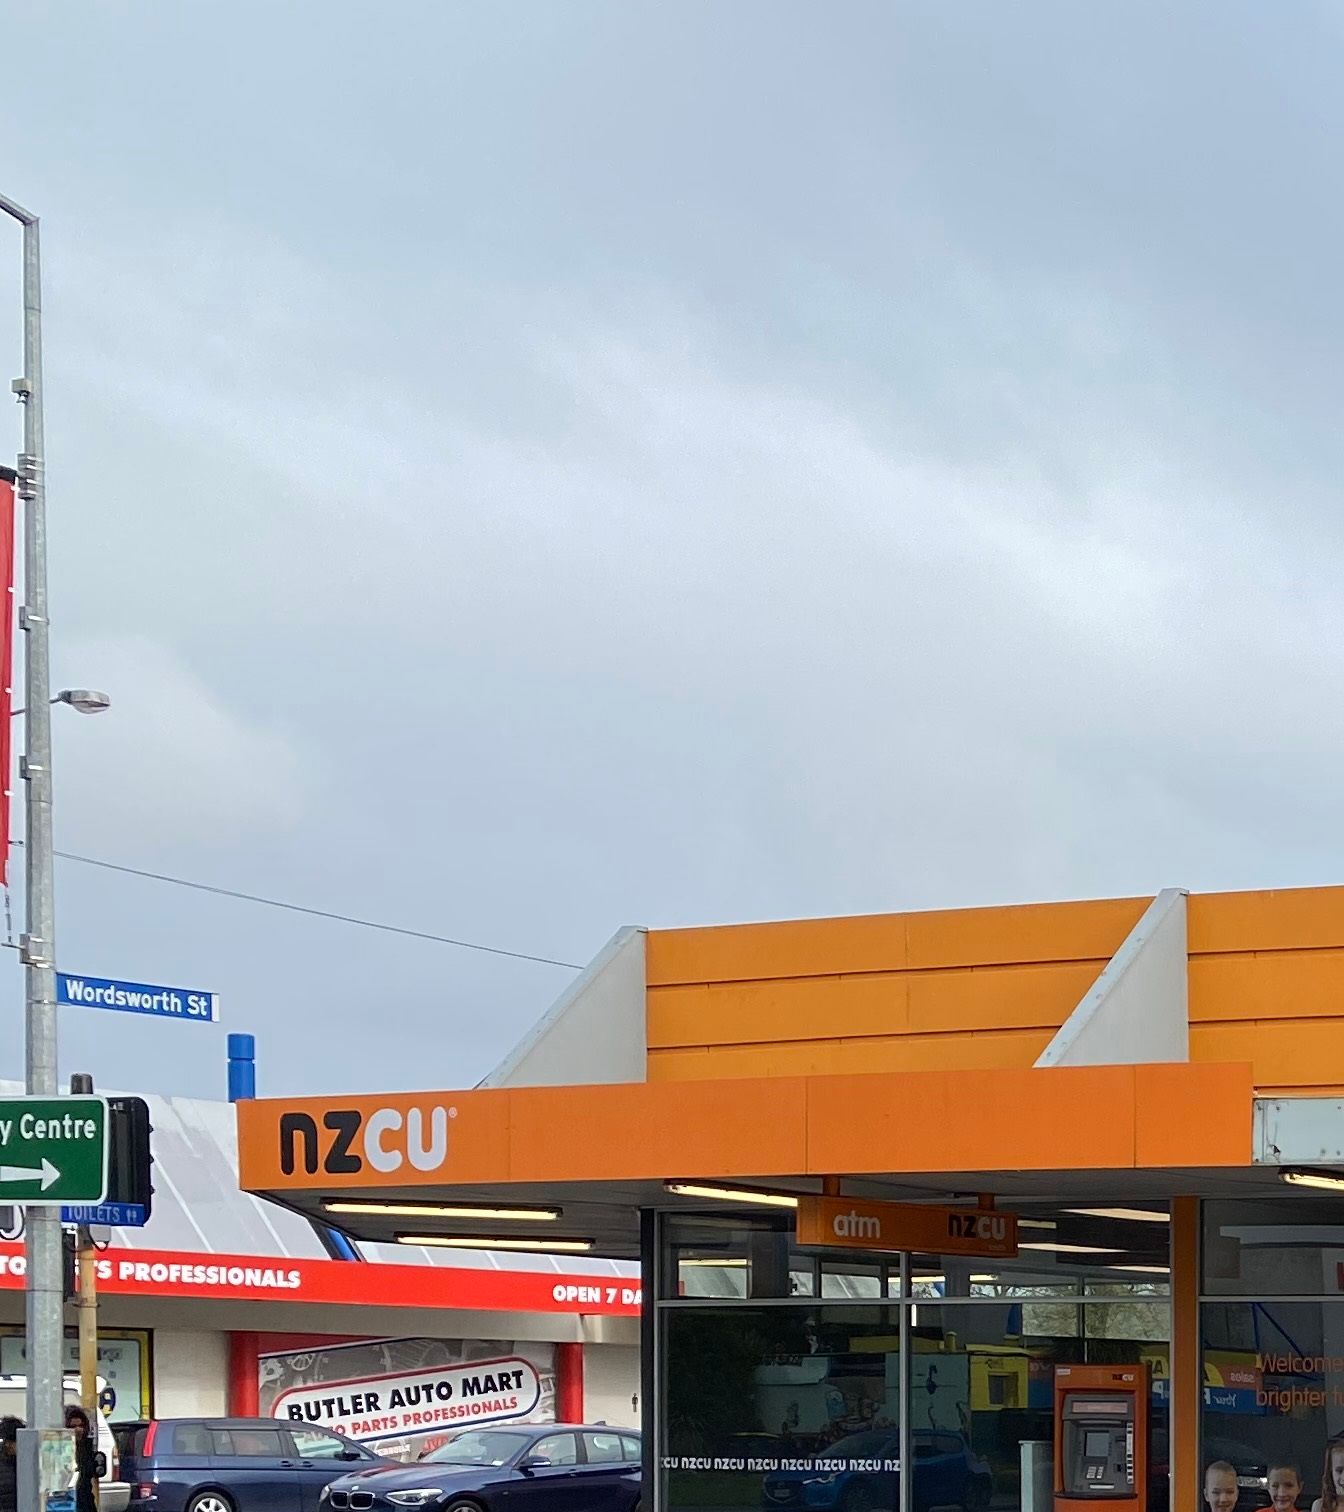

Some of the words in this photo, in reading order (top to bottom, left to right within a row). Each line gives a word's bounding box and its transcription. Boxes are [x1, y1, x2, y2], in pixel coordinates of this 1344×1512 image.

[65, 979, 182, 1013] Wordsworth
[187, 995, 207, 1016] St
[0, 1120, 13, 1146] y
[20, 1113, 96, 1140] Centre
[68, 1206, 120, 1222] TOILETS
[833, 1210, 881, 1239] atm
[119, 1261, 301, 1289] PROFESSIONALS
[553, 1285, 601, 1303] OPEN
[605, 1288, 617, 1304] 7
[622, 1289, 642, 1305] DA
[1256, 1351, 1344, 1374] Welcome
[287, 1392, 380, 1423] BUTLER
[389, 1381, 452, 1410] AUTO
[462, 1370, 524, 1398] MART
[1255, 1385, 1328, 1412] brighter
[352, 1417, 398, 1435] PARTS
[403, 1396, 519, 1427] PROFESSIONALS
